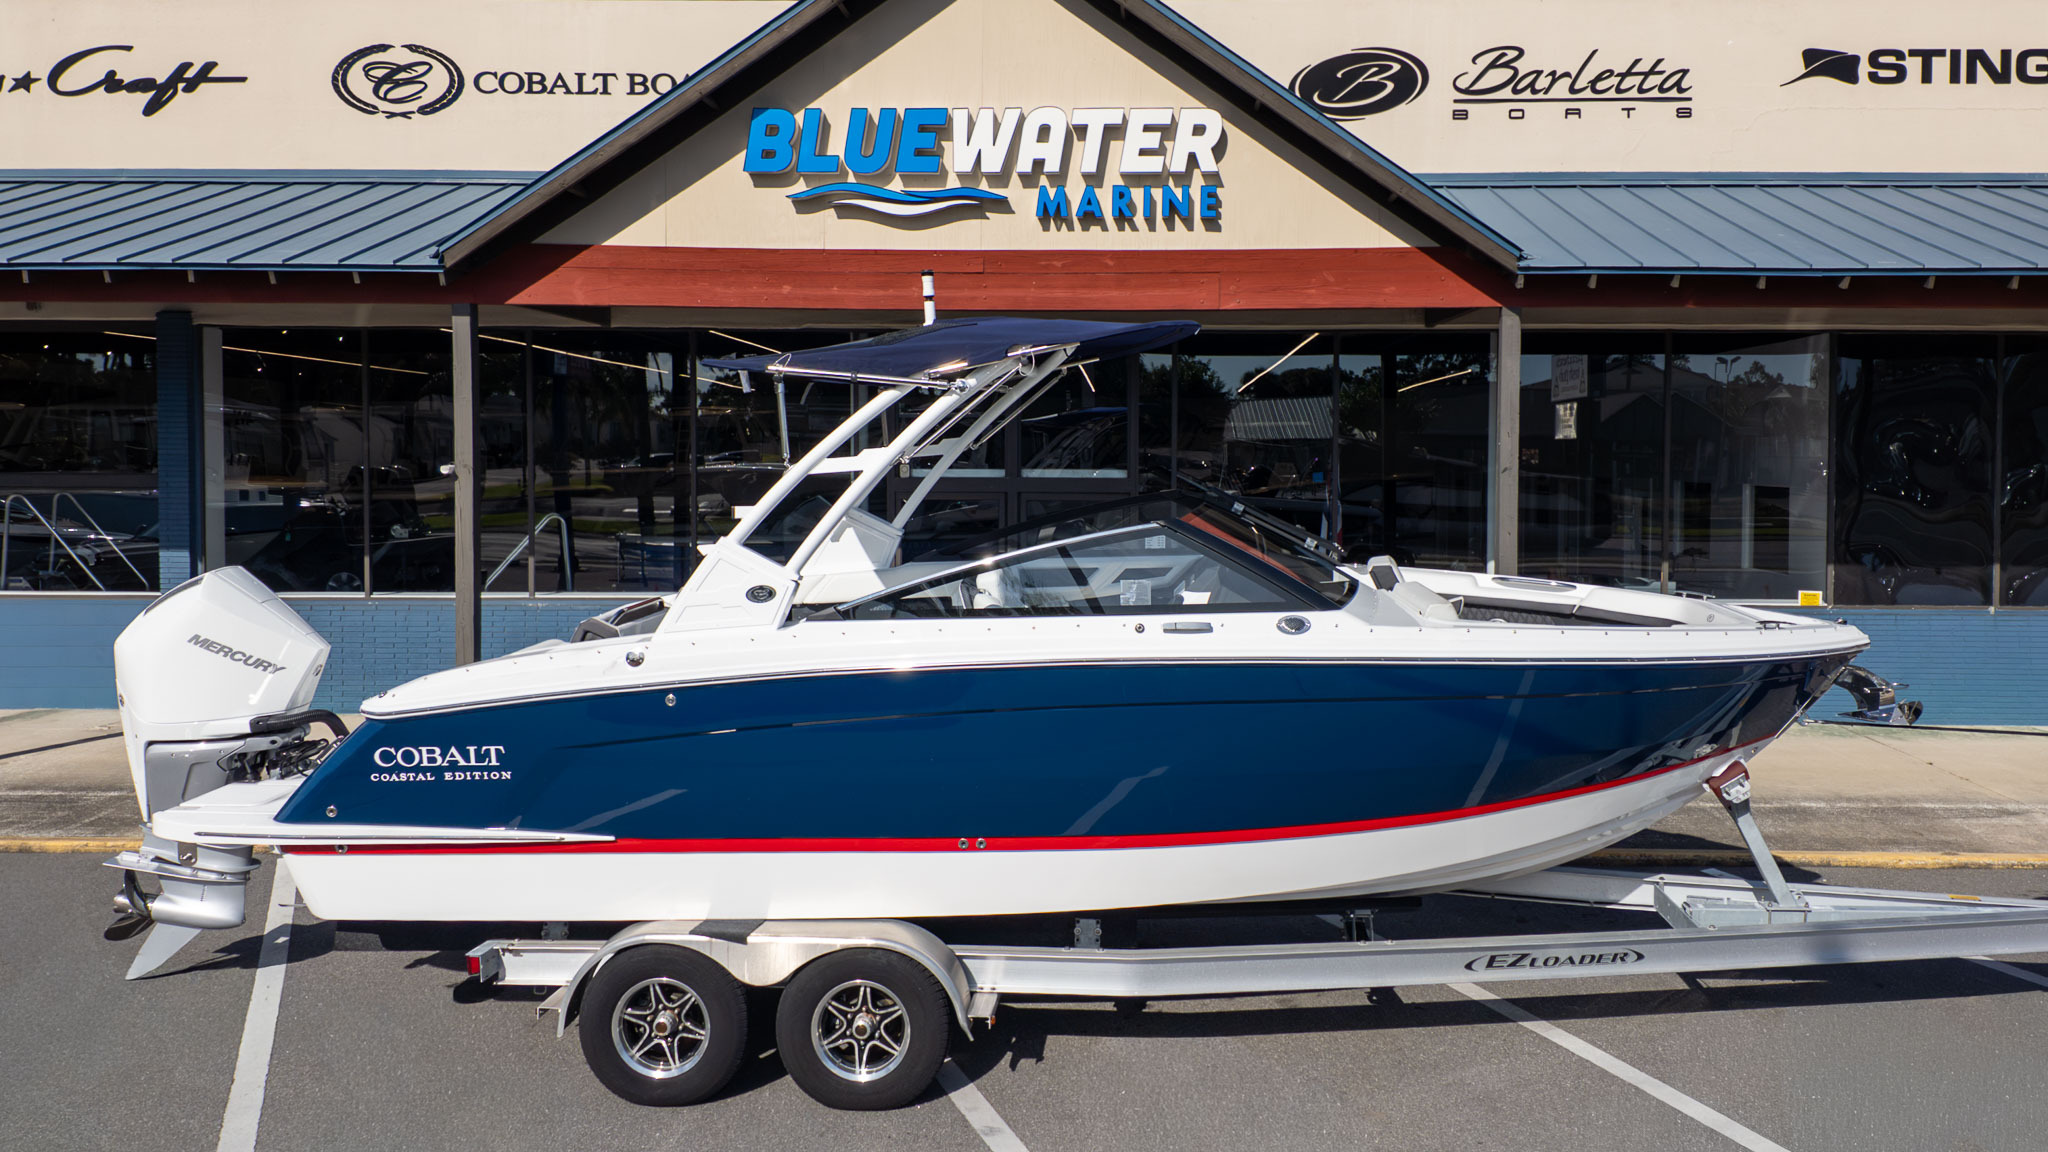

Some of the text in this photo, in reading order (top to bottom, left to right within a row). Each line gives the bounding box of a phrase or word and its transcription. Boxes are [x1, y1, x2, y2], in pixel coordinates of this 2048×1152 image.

[47, 44, 248, 117] Craft
[473, 71, 690, 96] COBALT BO
[1452, 45, 1693, 96] Barletta
[1867, 48, 2048, 85] STING
[1452, 107, 1693, 120] BOATS
[1036, 184, 1218, 218] MARINE
[187, 633, 287, 675] MERCURY
[373, 745, 506, 768] COBALT
[370, 771, 512, 782] COASTAL EDITION
